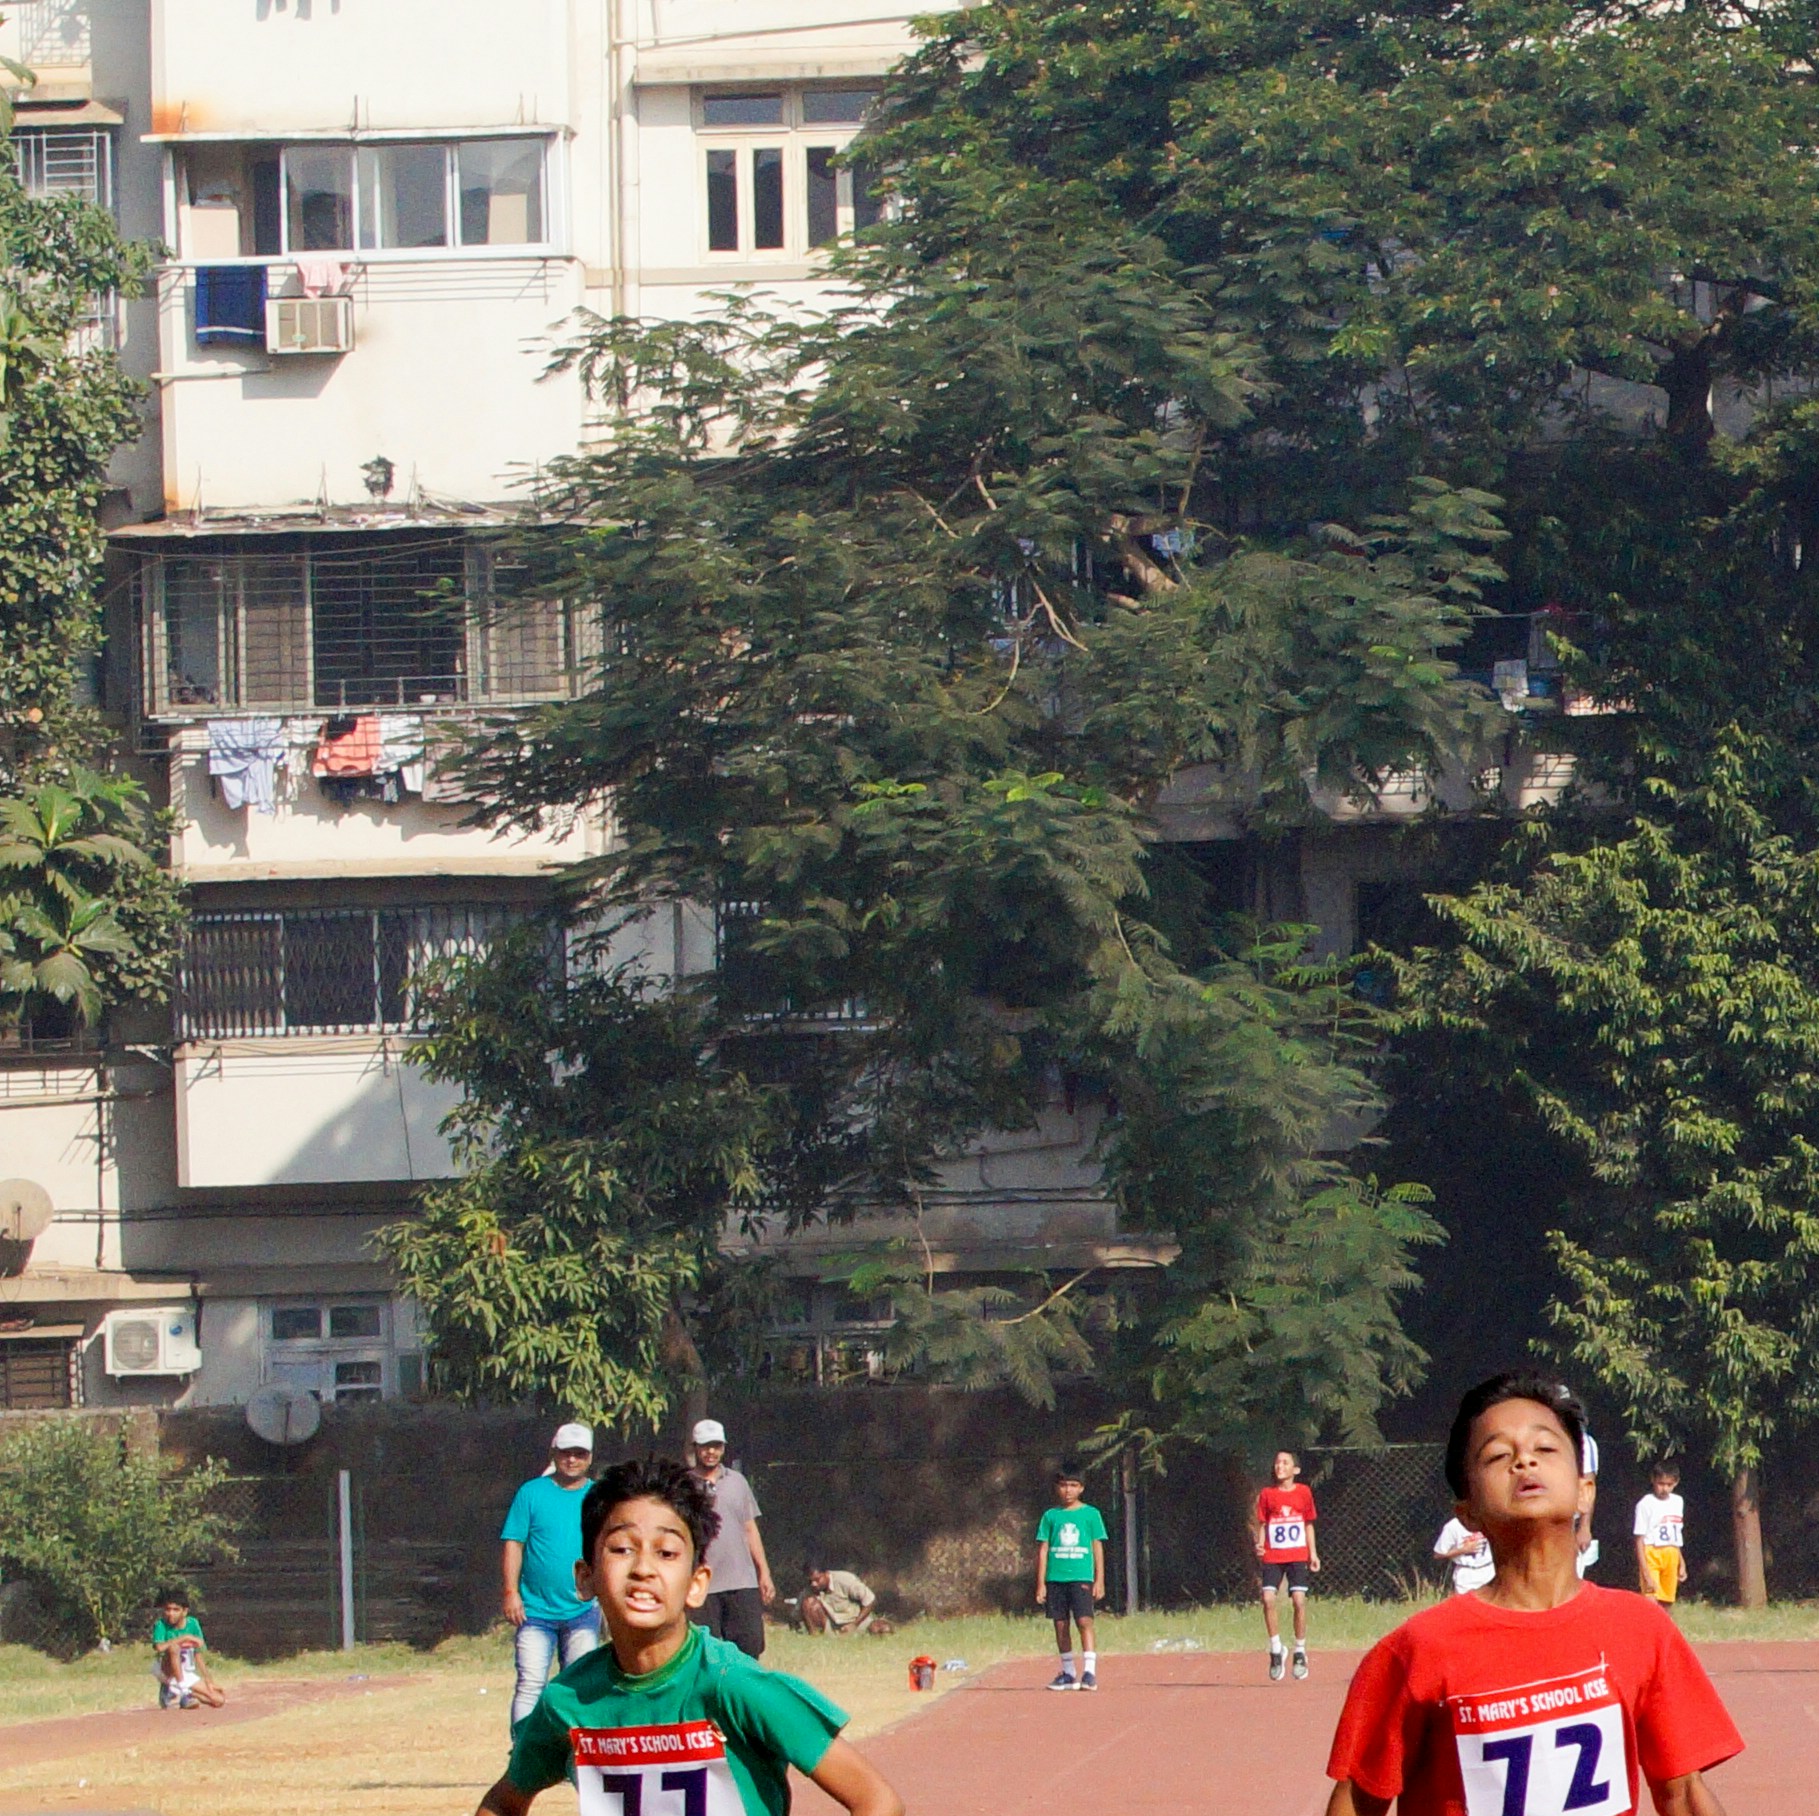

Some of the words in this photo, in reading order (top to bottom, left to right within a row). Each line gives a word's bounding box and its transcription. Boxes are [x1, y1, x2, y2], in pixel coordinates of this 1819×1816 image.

[1274, 1525, 1300, 1543] 80
[1660, 1525, 1677, 1542] 81
[1459, 1707, 1476, 1723] ST.
[1478, 1699, 1529, 1722] MARY'S
[1532, 1687, 1582, 1712] SCHOOL
[1583, 1678, 1609, 1700] ICSE
[580, 1738, 596, 1754] ST.
[599, 1736, 638, 1755] MARY'S
[640, 1736, 684, 1753] SCHOOL
[686, 1731, 714, 1749] ICSE
